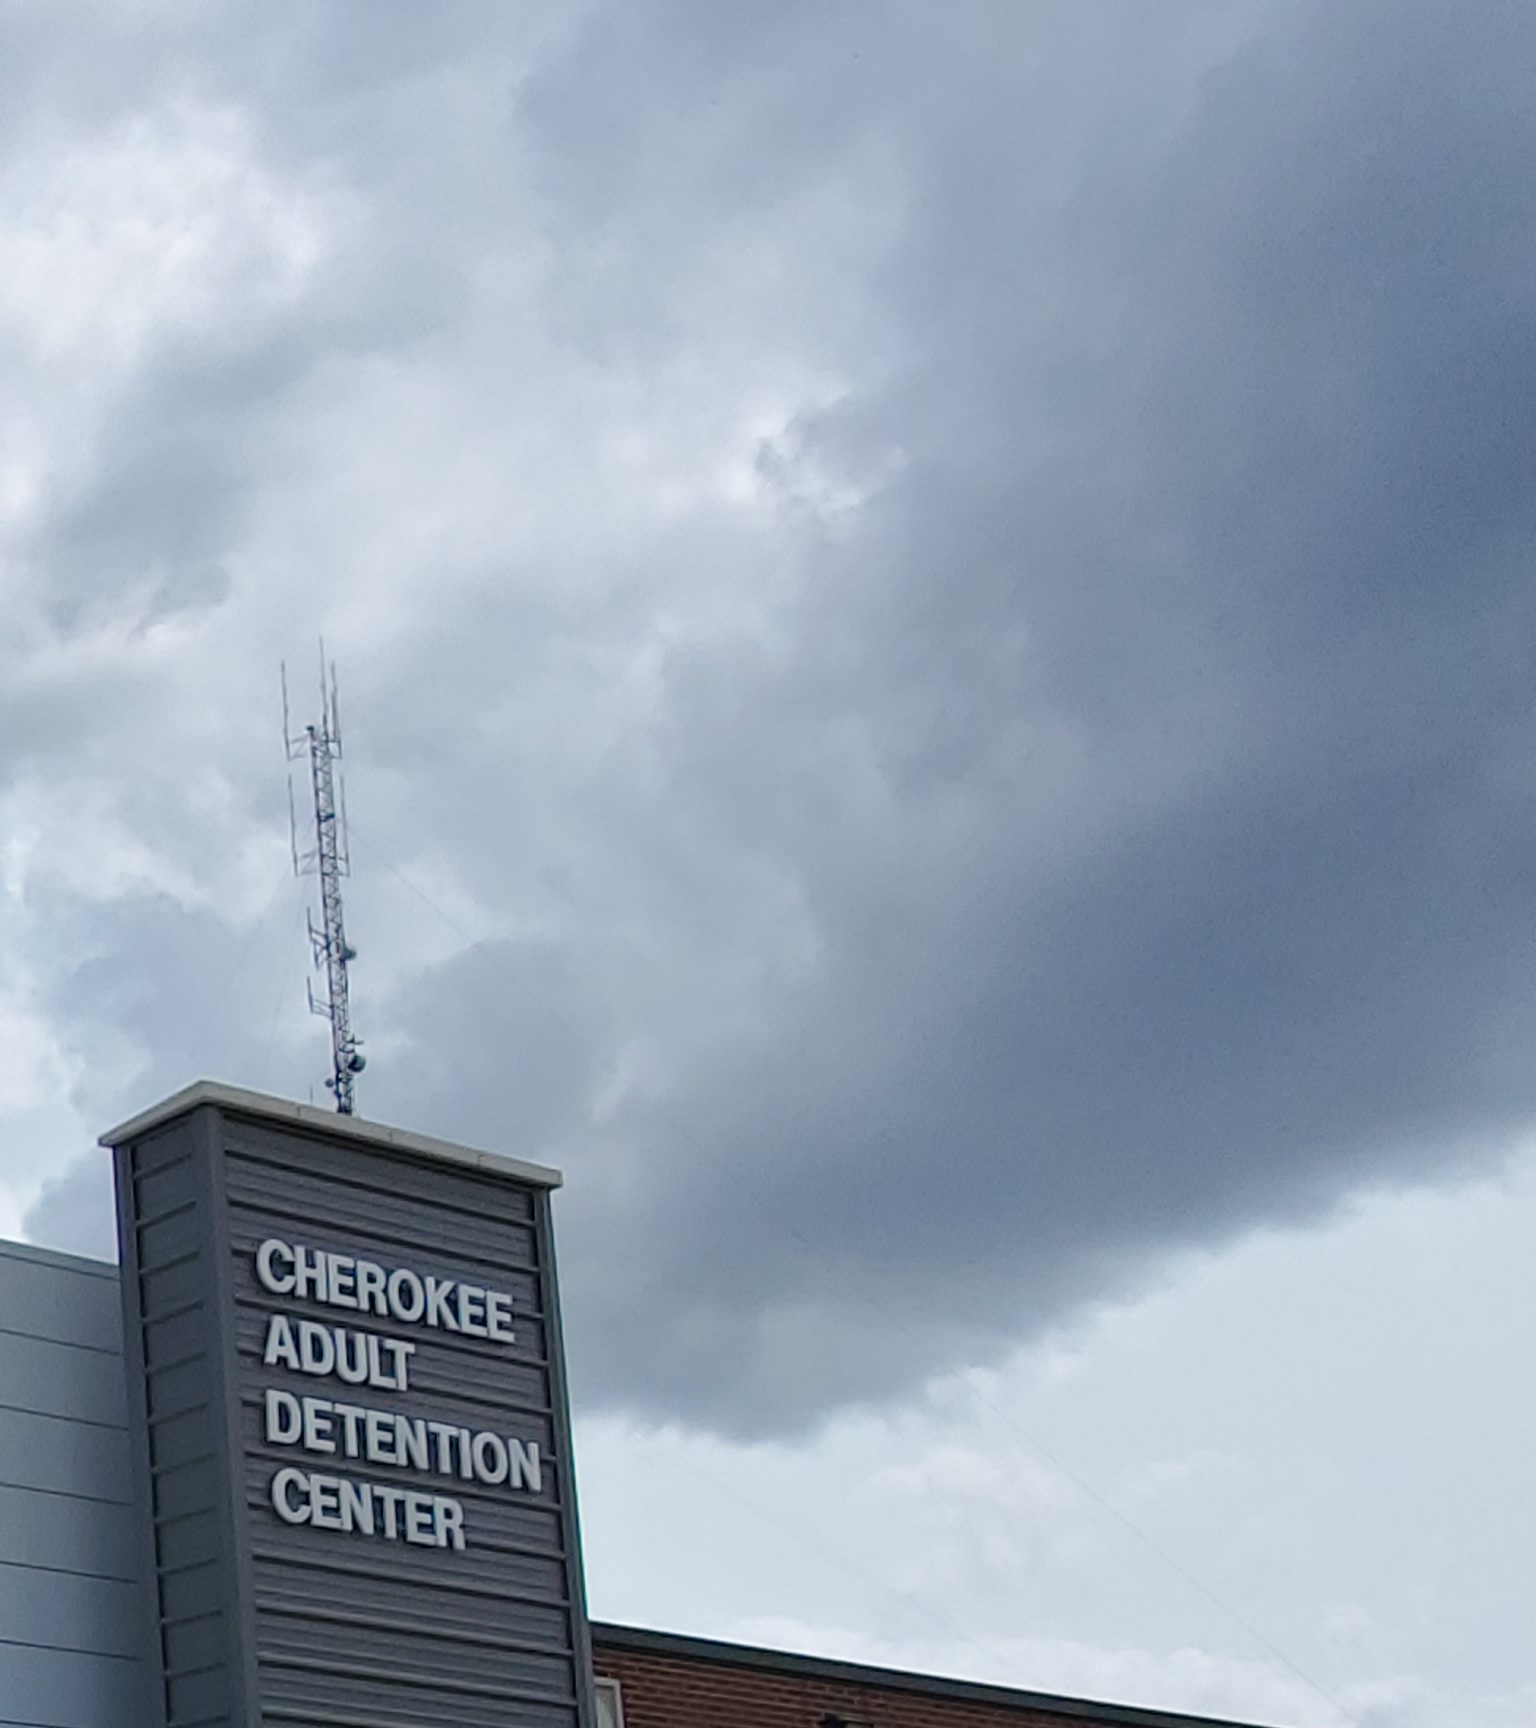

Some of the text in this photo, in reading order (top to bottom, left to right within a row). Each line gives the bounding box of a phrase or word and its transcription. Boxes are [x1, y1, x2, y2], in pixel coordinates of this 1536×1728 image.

[257, 1238, 515, 1343] CHEROKEE
[264, 1314, 415, 1392] ADULT
[265, 1389, 541, 1493] DETENTION
[271, 1467, 466, 1550] CENTER
